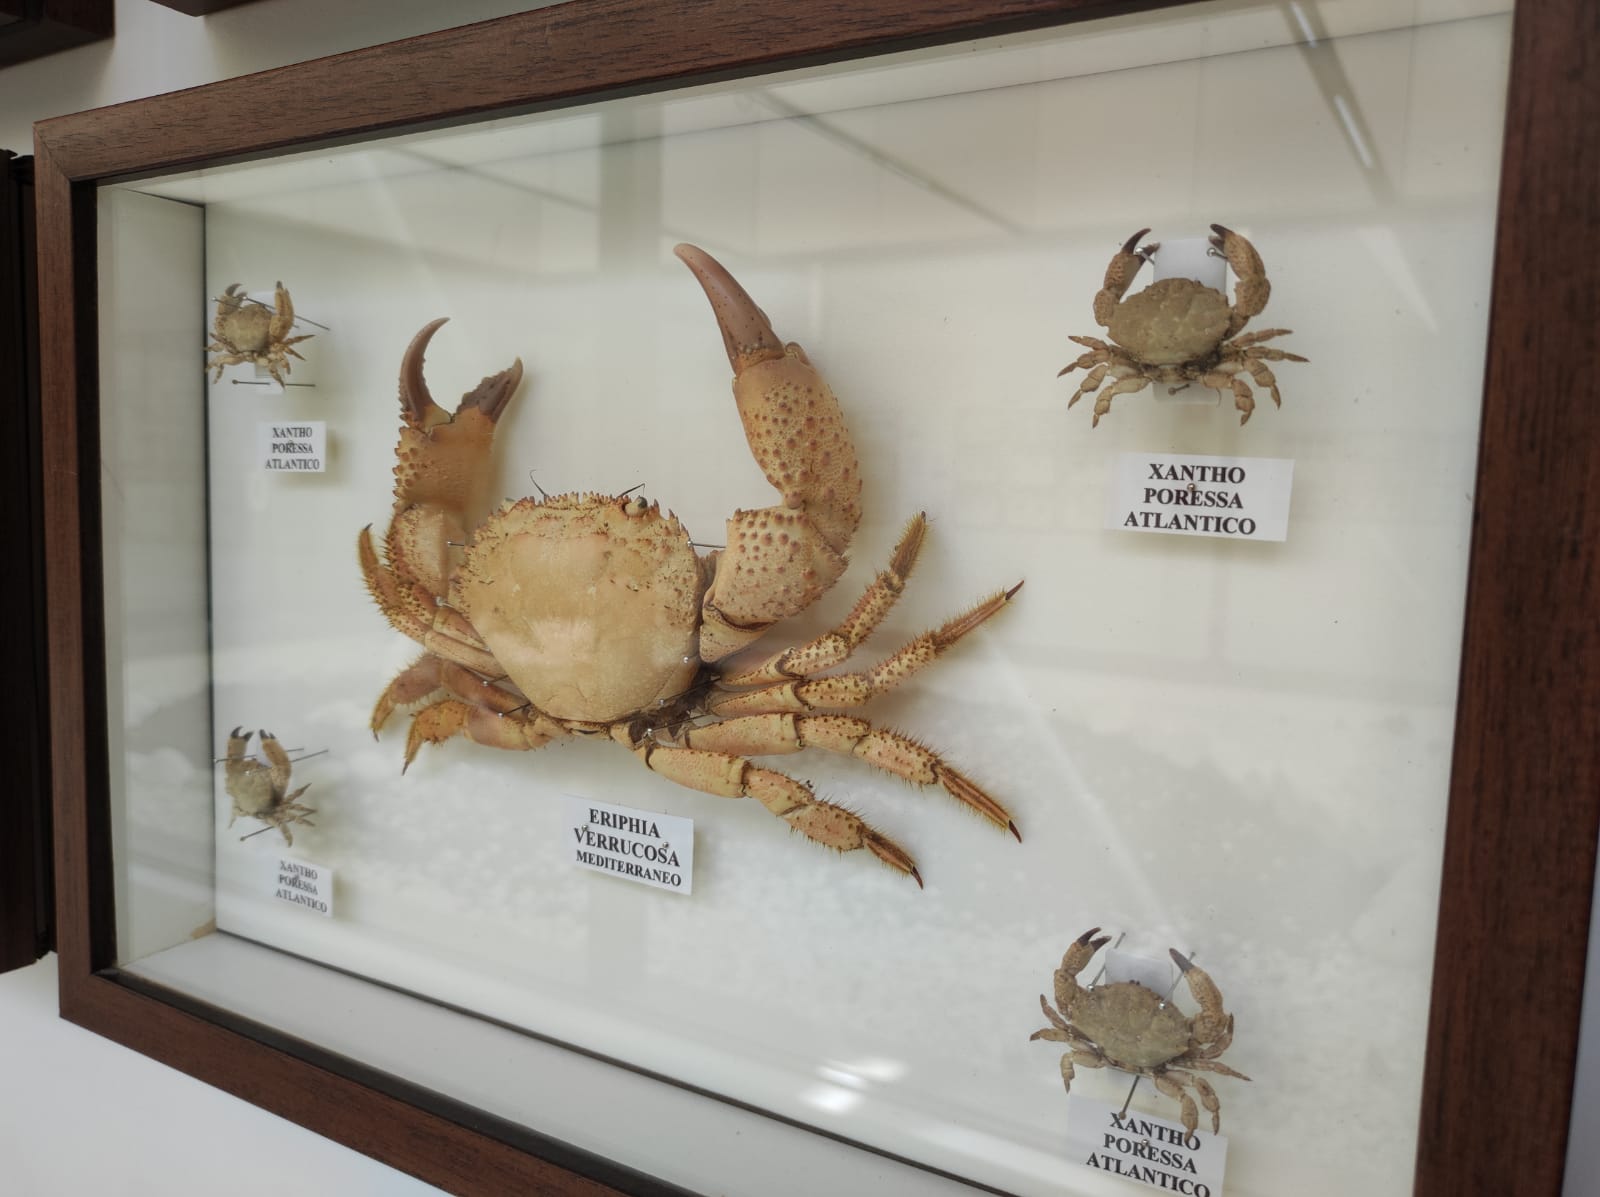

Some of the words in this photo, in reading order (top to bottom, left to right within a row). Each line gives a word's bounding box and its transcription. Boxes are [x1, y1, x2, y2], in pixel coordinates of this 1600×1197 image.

[272, 427, 313, 438] XANTHO
[272, 443, 314, 453] PORESSA
[264, 459, 320, 469] ATLANTICO
[1148, 463, 1246, 484] XANTHO
[1143, 487, 1244, 509] PORESSA
[1124, 511, 1256, 535] ATLANTICO
[589, 807, 661, 838] ERIPHIA
[574, 827, 681, 867] VERRUCOSA
[280, 860, 318, 880] XANTHO
[576, 849, 682, 887] MEDITERRANEO
[278, 874, 318, 895] PORESSA
[275, 888, 328, 912] ATLANTICO
[1110, 1112, 1201, 1151] XANTHO
[1103, 1132, 1198, 1174] PORESSA
[1086, 1152, 1211, 1197] ATLANTICO
